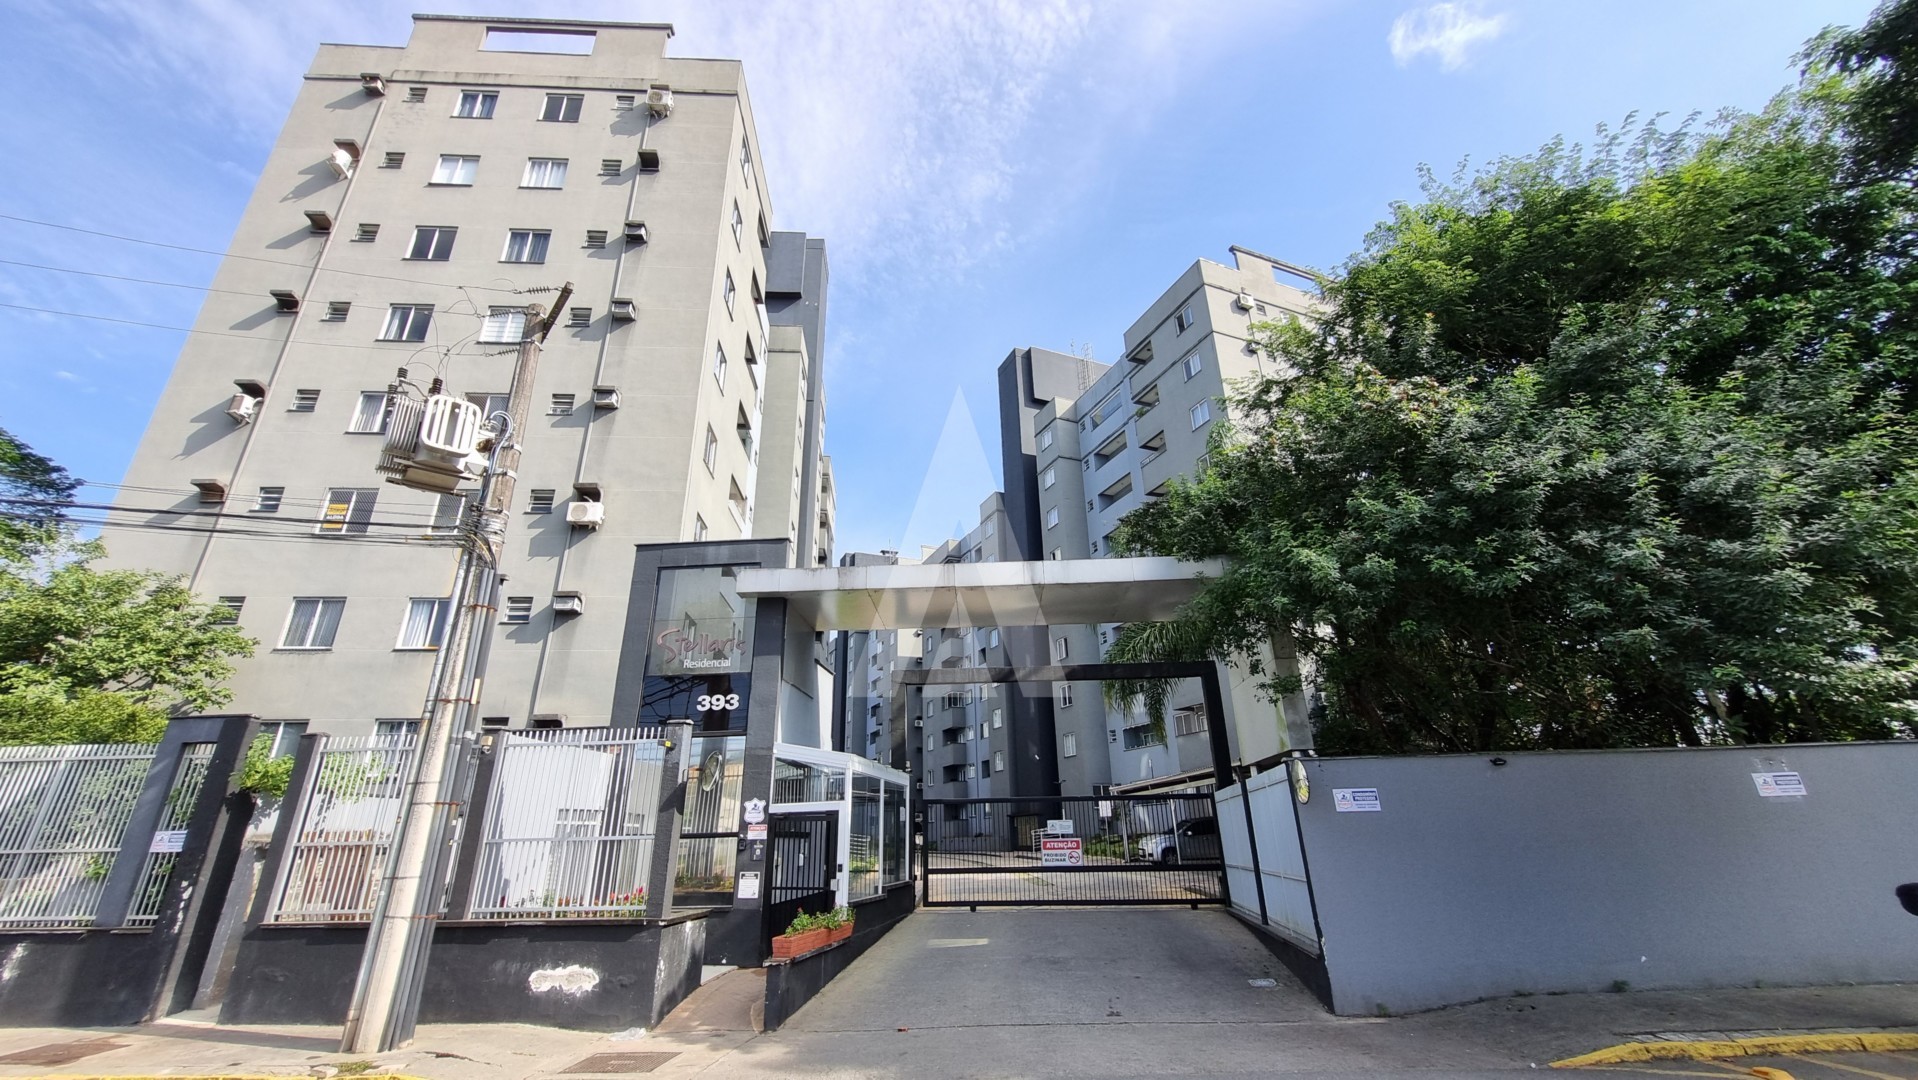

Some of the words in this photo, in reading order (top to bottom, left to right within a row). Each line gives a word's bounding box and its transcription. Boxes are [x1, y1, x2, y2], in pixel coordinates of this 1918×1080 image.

[683, 657, 731, 668] Residencial
[696, 693, 740, 711] 393
[1046, 841, 1077, 849] ATENÇÃO
